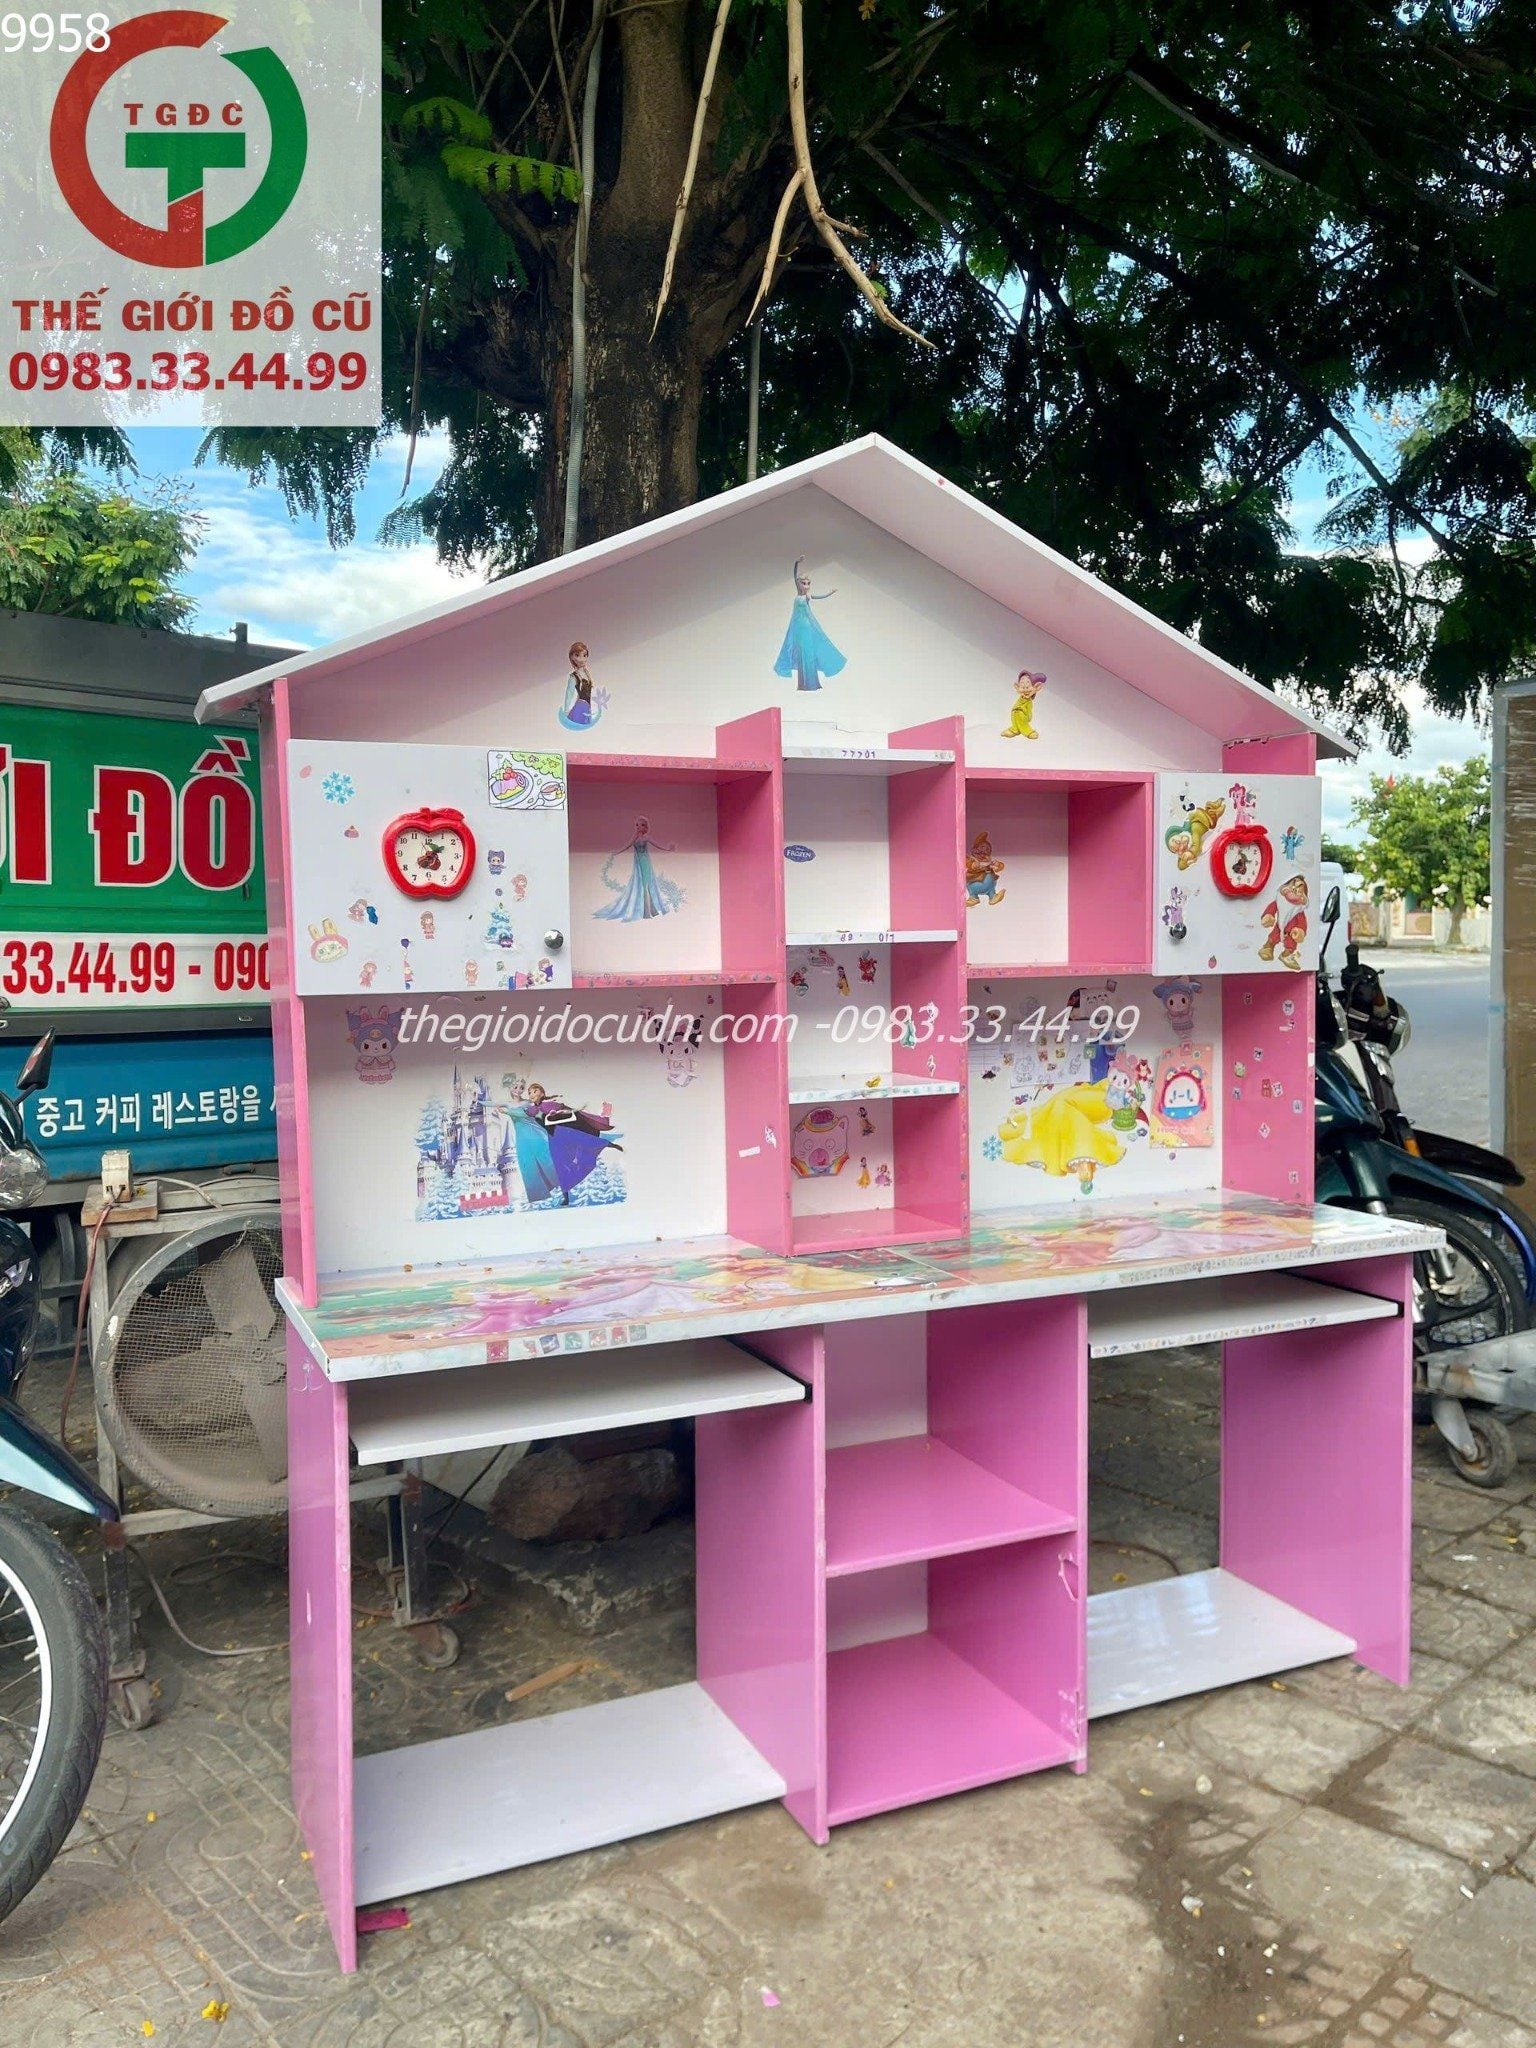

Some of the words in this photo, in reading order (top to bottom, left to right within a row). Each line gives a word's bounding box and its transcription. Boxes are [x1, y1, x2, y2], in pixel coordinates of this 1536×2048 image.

[88, 735, 256, 891] ĐỒ
[2, 940, 176, 995] 33.44.99
[36, 1097, 86, 1138] 중고
[95, 1093, 141, 1134] 커피
[151, 1085, 261, 1130] 레스토랑을
